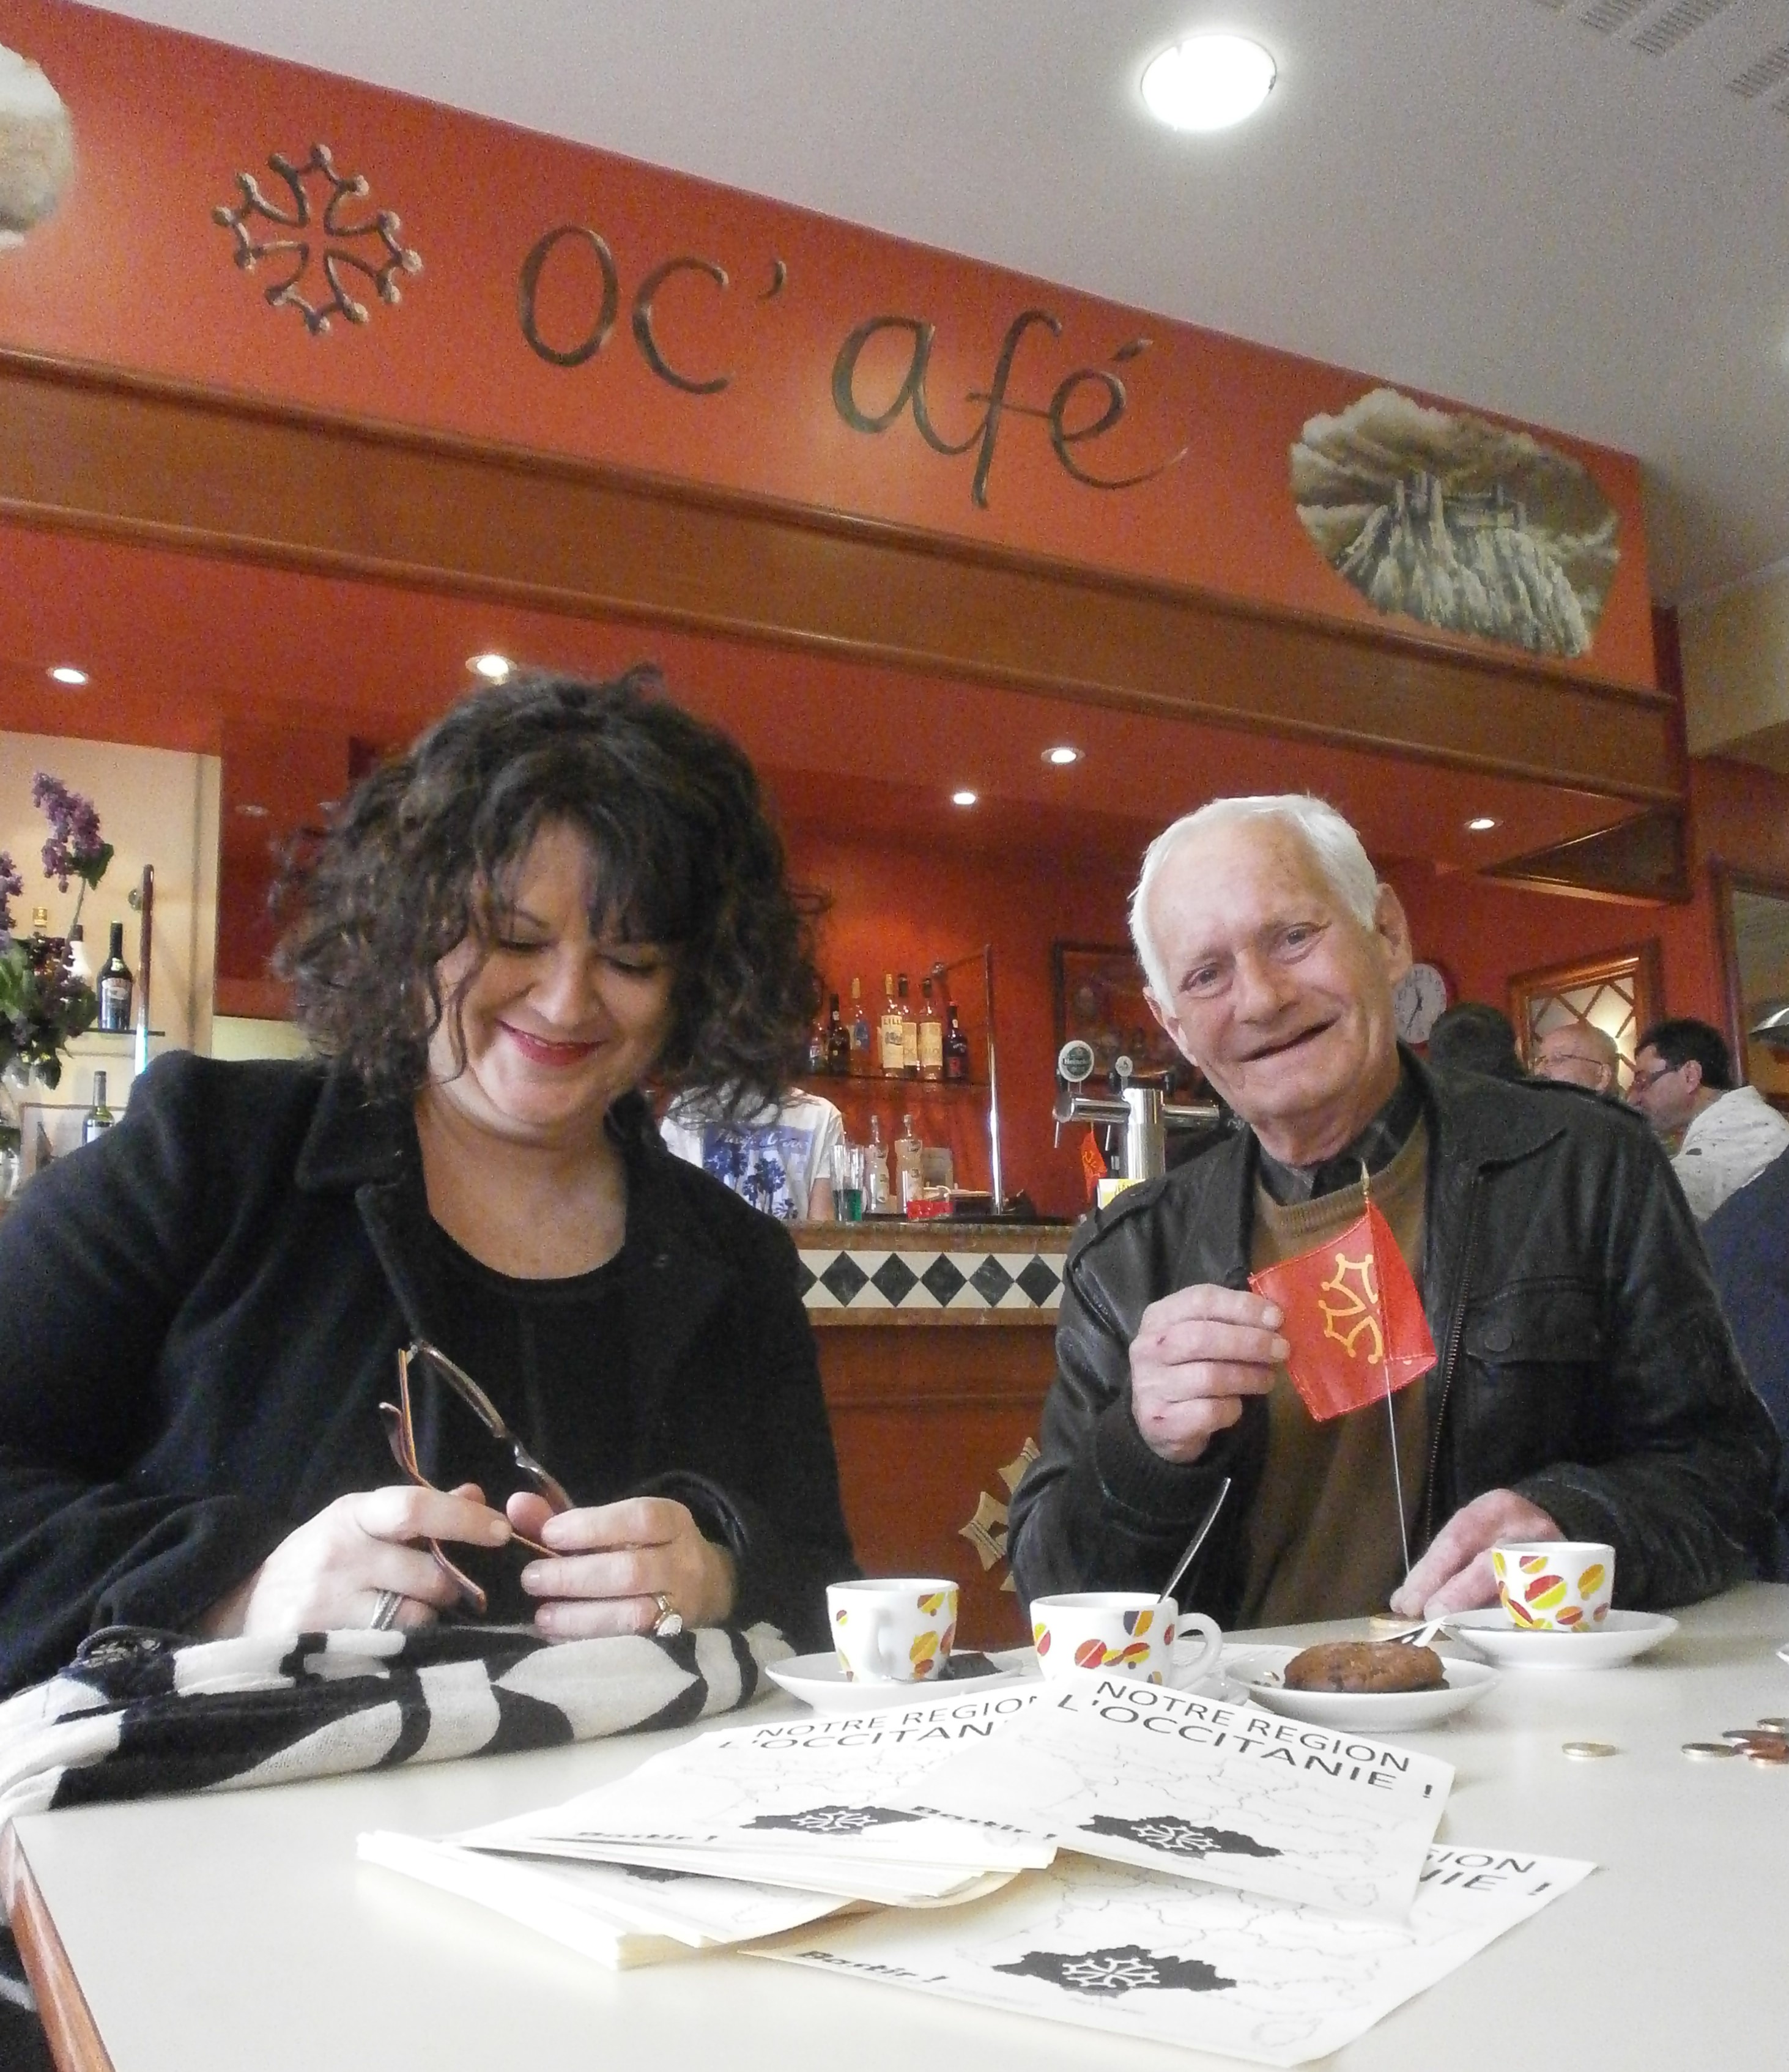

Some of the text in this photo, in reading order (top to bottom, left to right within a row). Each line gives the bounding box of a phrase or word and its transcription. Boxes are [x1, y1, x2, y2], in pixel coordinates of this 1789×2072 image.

[719, 1720, 1009, 1749] L'OCCITAN
[757, 1716, 887, 1737] NOTRE
[1057, 1694, 1434, 1798] L'OCCITANIE !
[1096, 1681, 1409, 1772] NOTRE REGION
